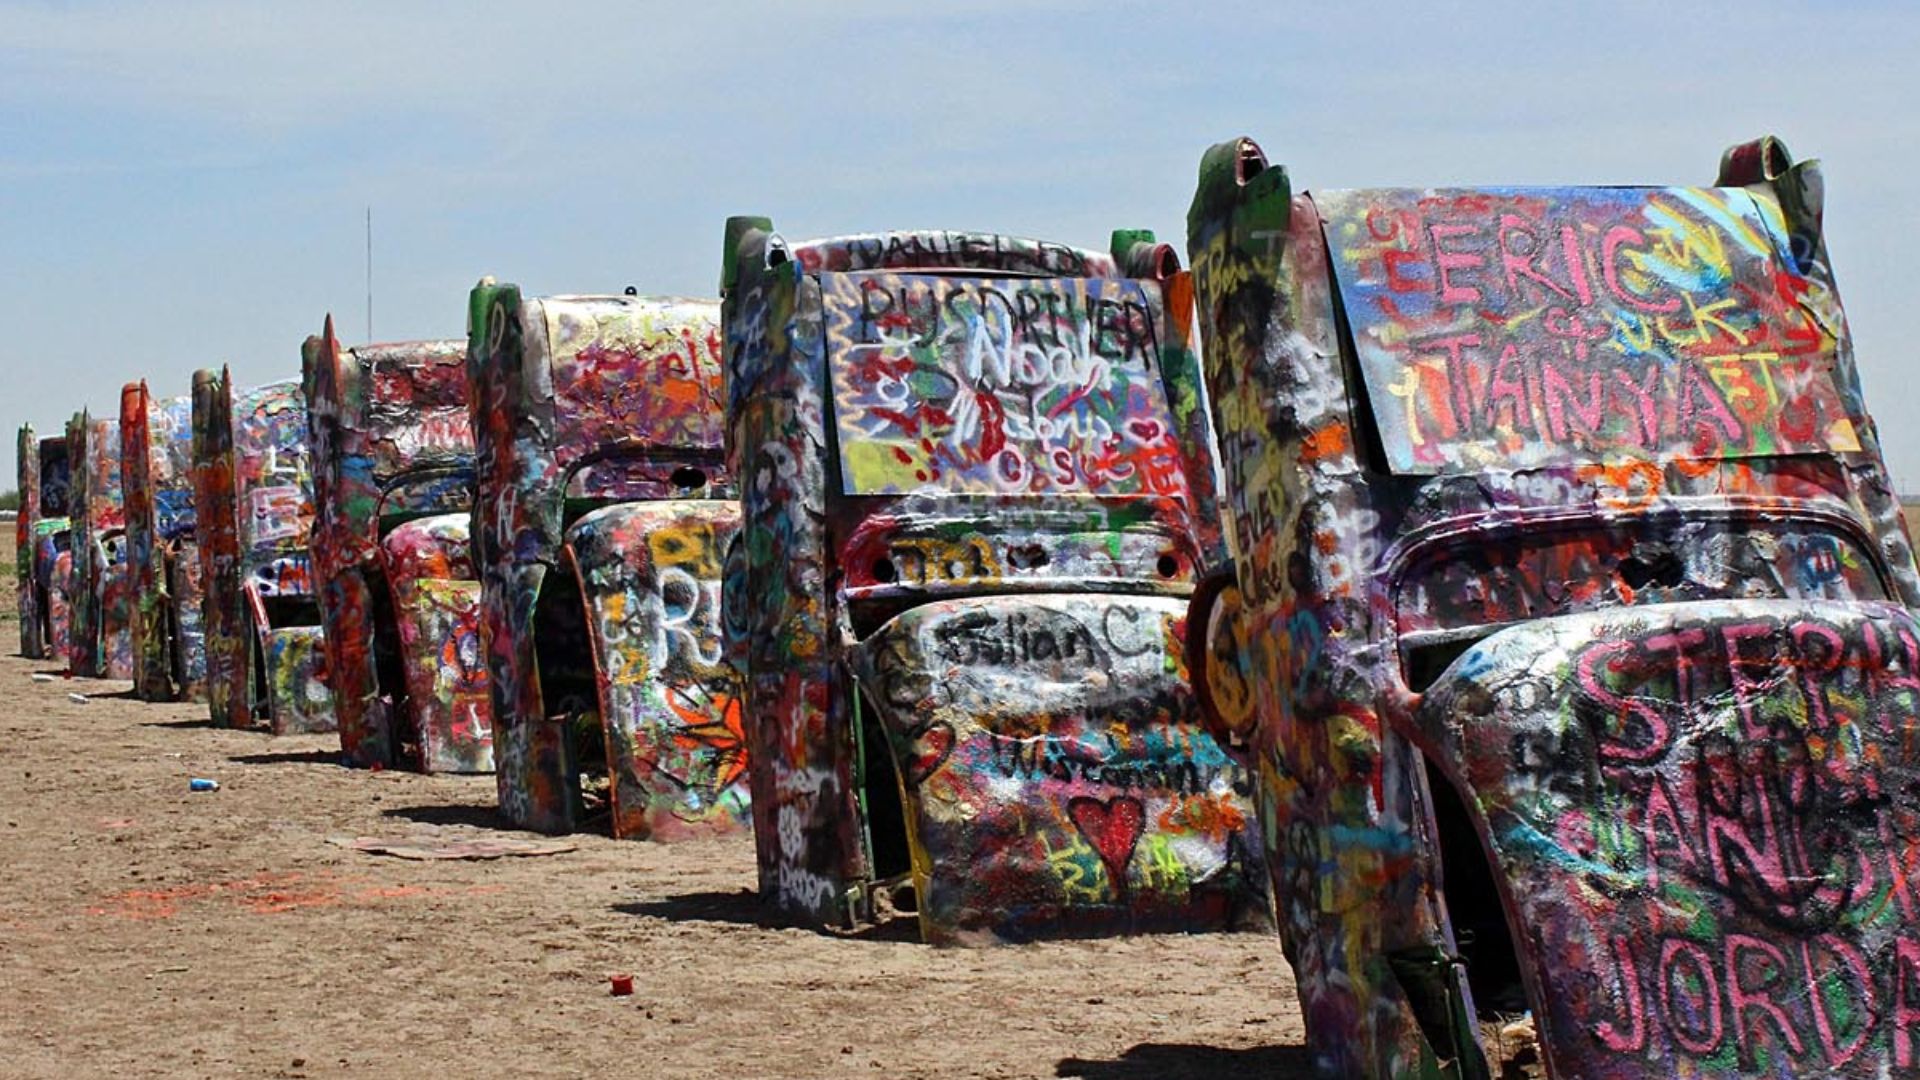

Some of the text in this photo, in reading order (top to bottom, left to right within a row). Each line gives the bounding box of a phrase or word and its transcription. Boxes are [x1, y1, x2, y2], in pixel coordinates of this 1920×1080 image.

[1429, 212, 1682, 312] ERIC
[966, 311, 1112, 389] Noah
[1414, 332, 1742, 448] TANYA
